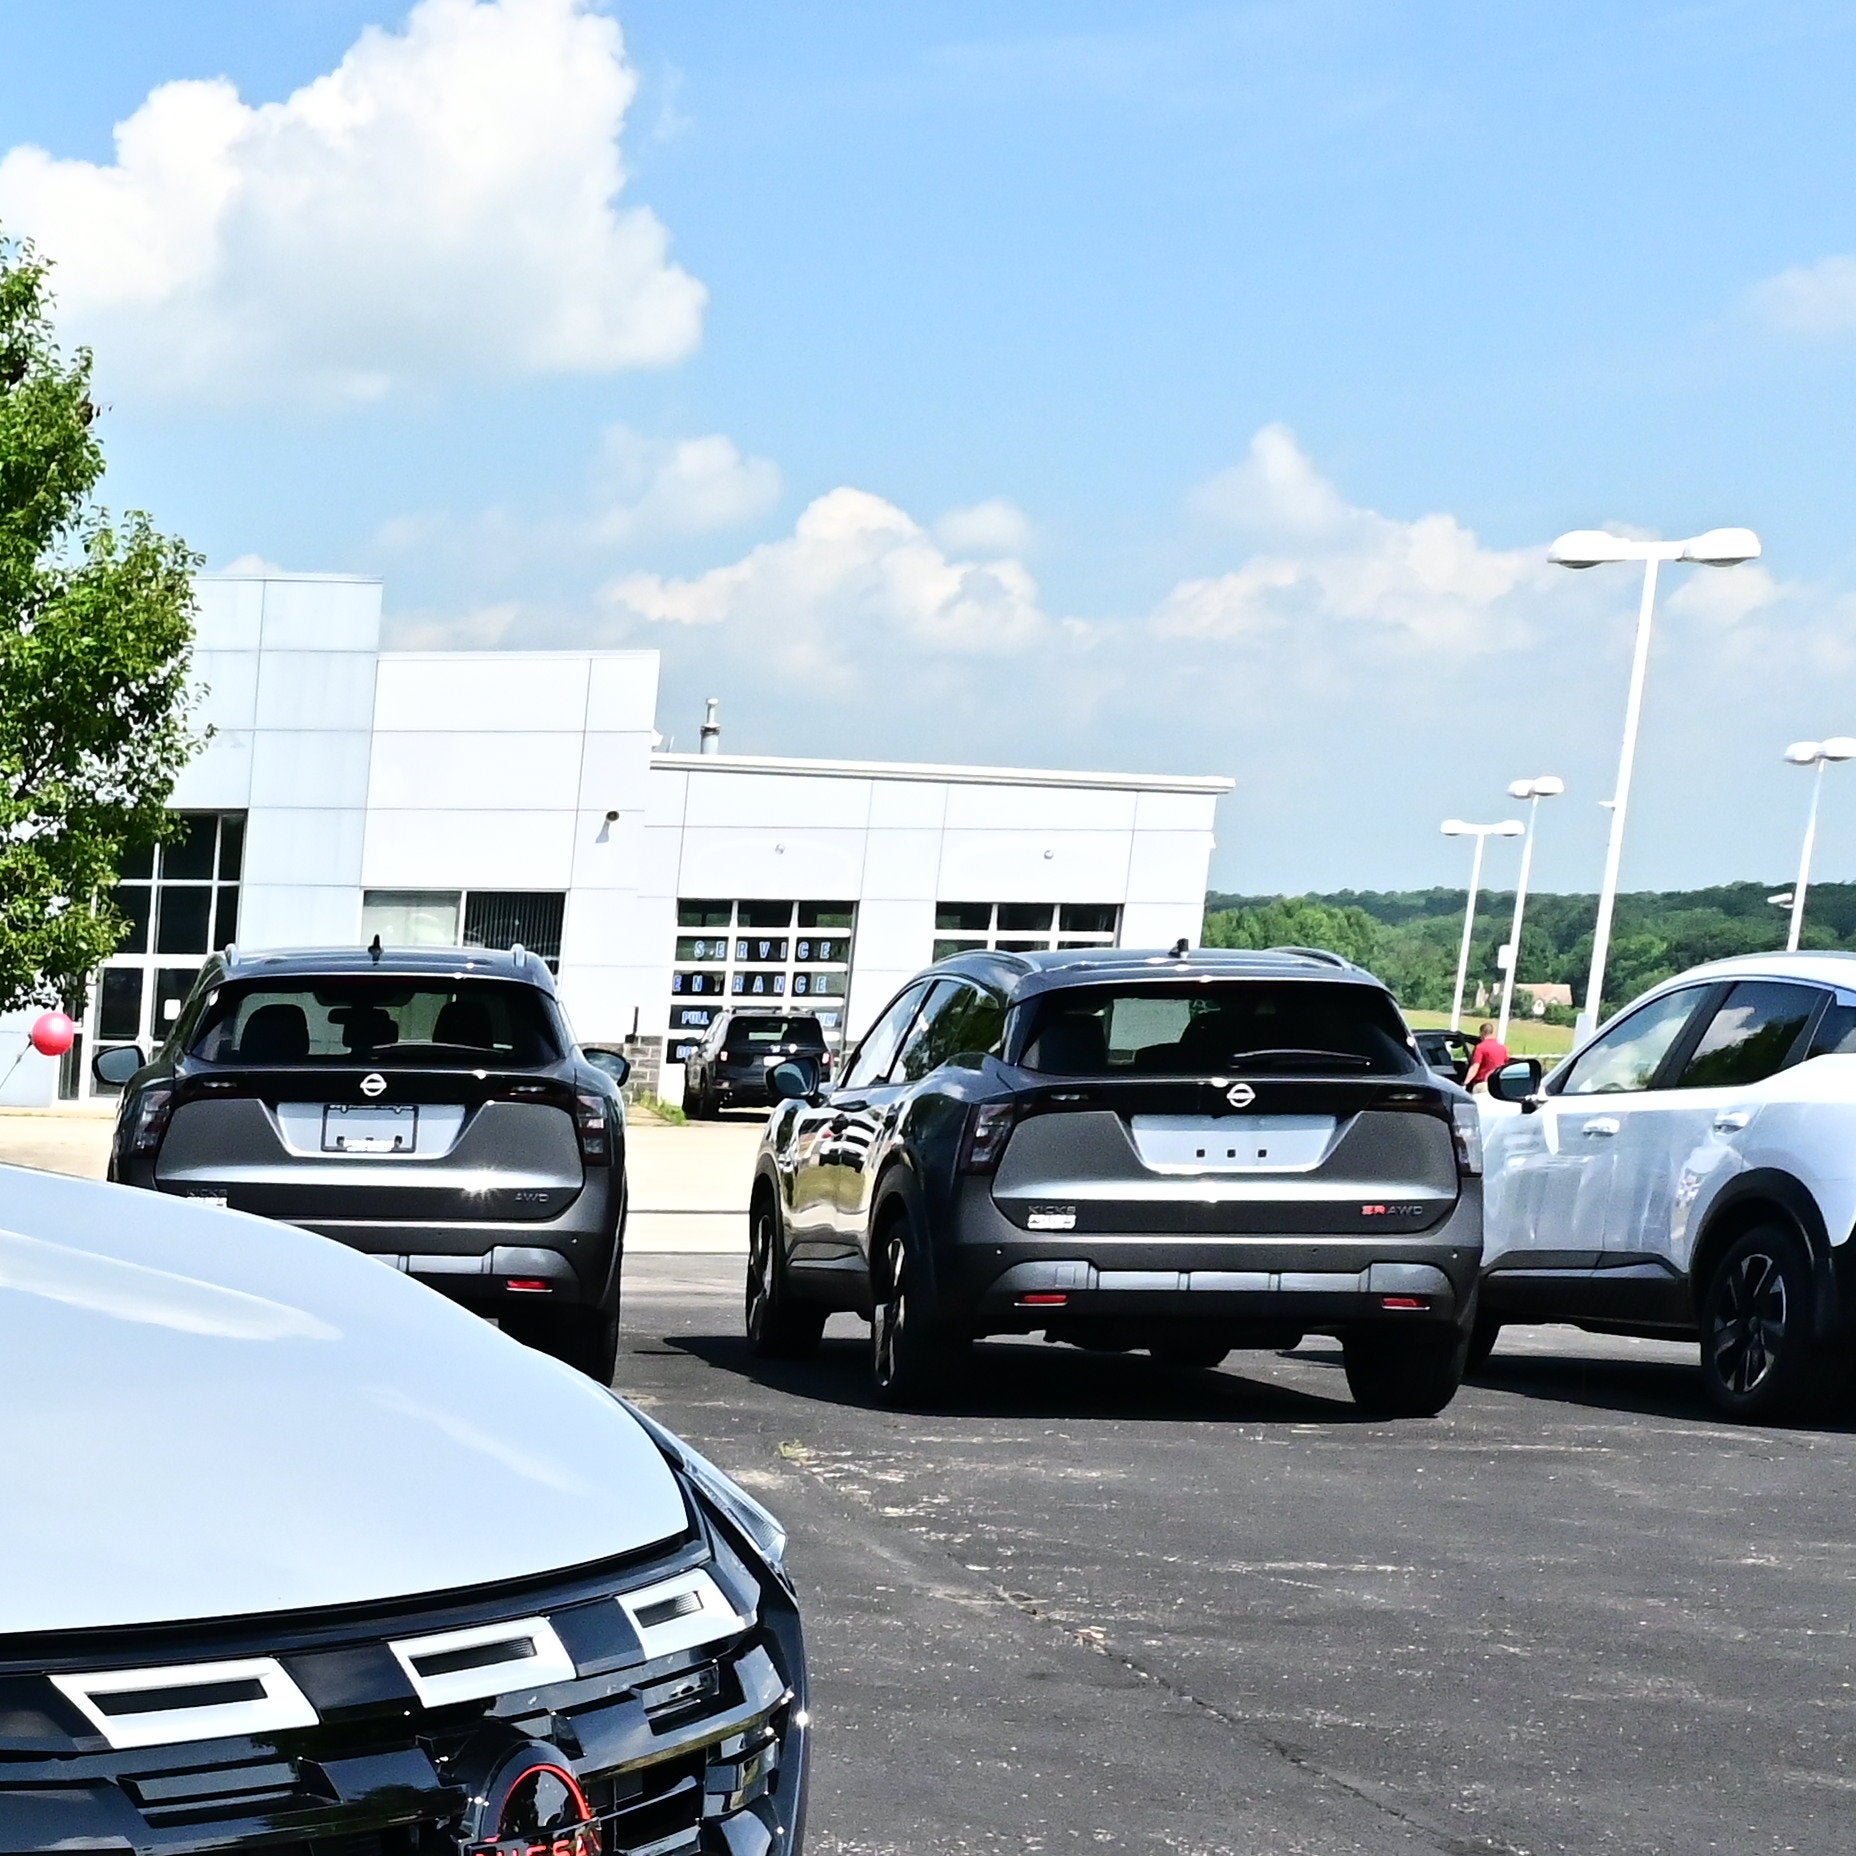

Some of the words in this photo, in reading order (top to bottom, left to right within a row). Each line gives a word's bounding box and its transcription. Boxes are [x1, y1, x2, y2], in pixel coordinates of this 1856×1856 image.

[694, 940, 831, 959] SERVICE
[514, 1192, 550, 1202] AWD
[1028, 1205, 1076, 1215] KICKS
[1387, 1205, 1424, 1215] AWD
